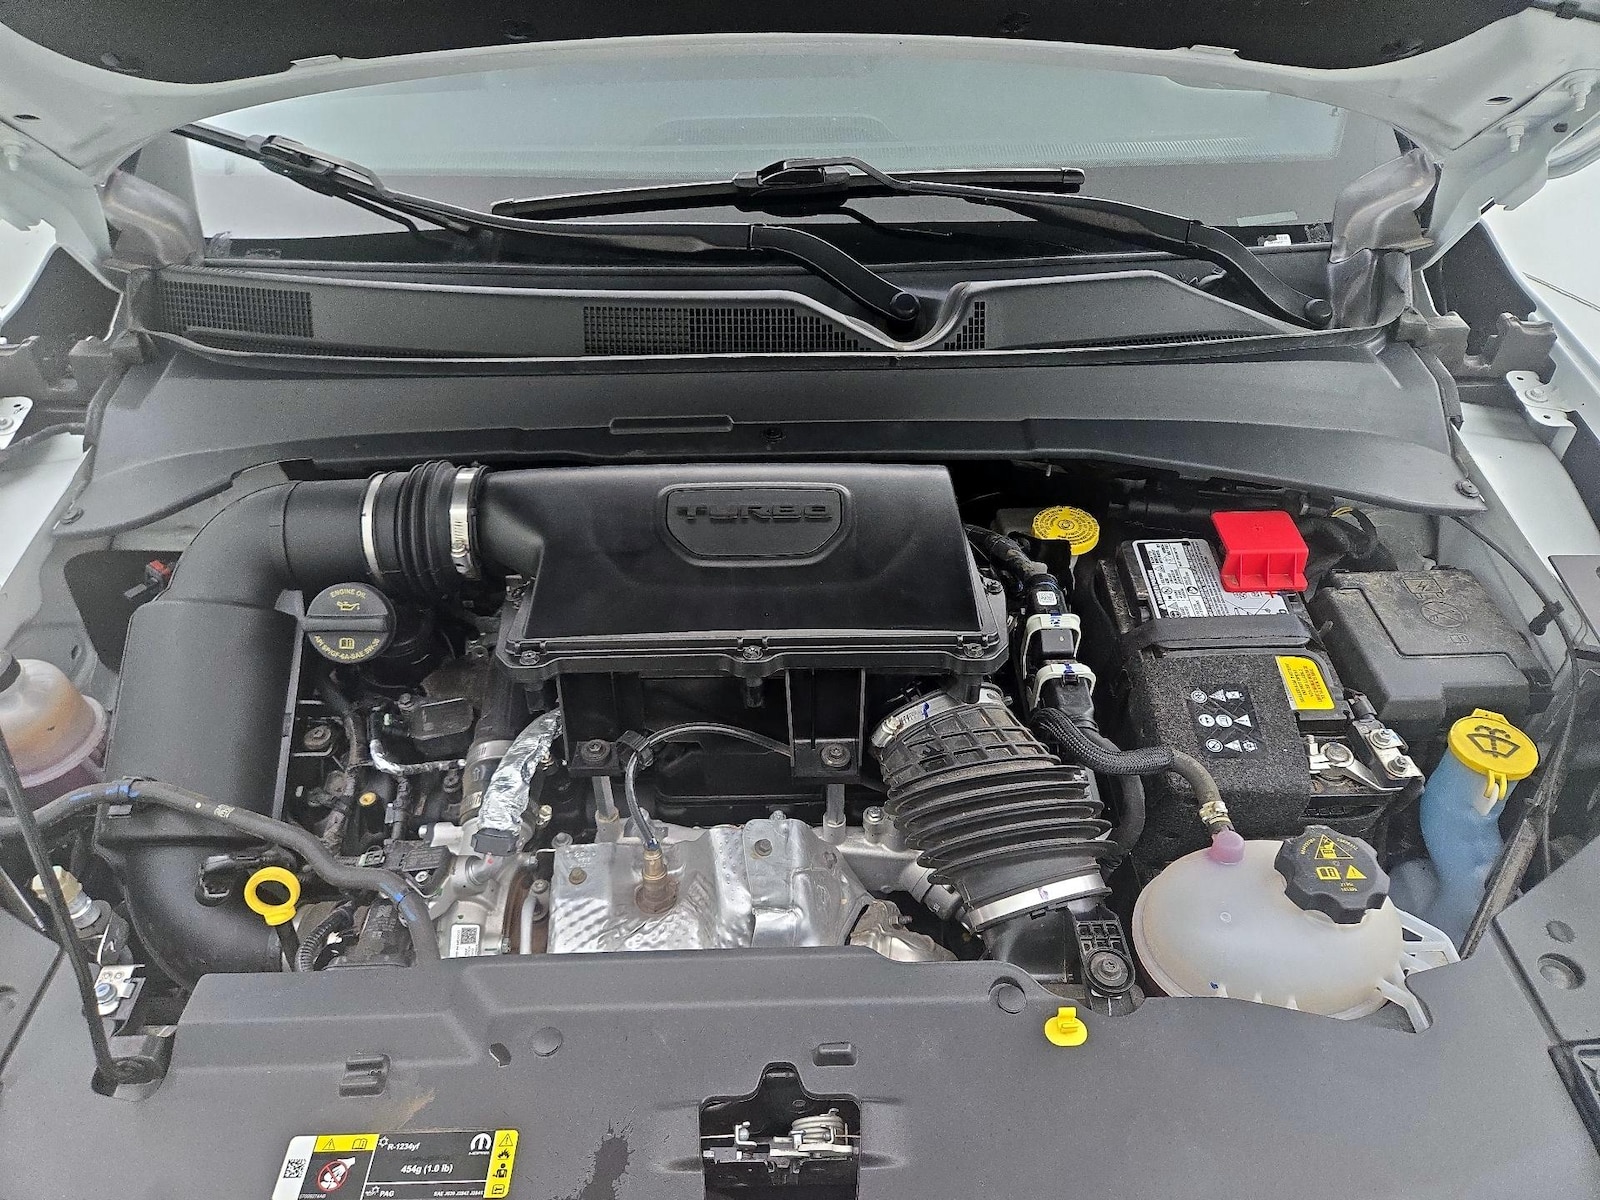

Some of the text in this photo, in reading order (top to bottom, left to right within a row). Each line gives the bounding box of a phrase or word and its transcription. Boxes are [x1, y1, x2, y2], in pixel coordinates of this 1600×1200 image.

[676, 504, 833, 523] TURBO
[330, 588, 367, 599] ENGINE OIL
[387, 1142, 420, 1151] R-1234yf
[400, 1163, 453, 1175] 454g (1.0 lb)
[379, 1190, 395, 1198] PAG
